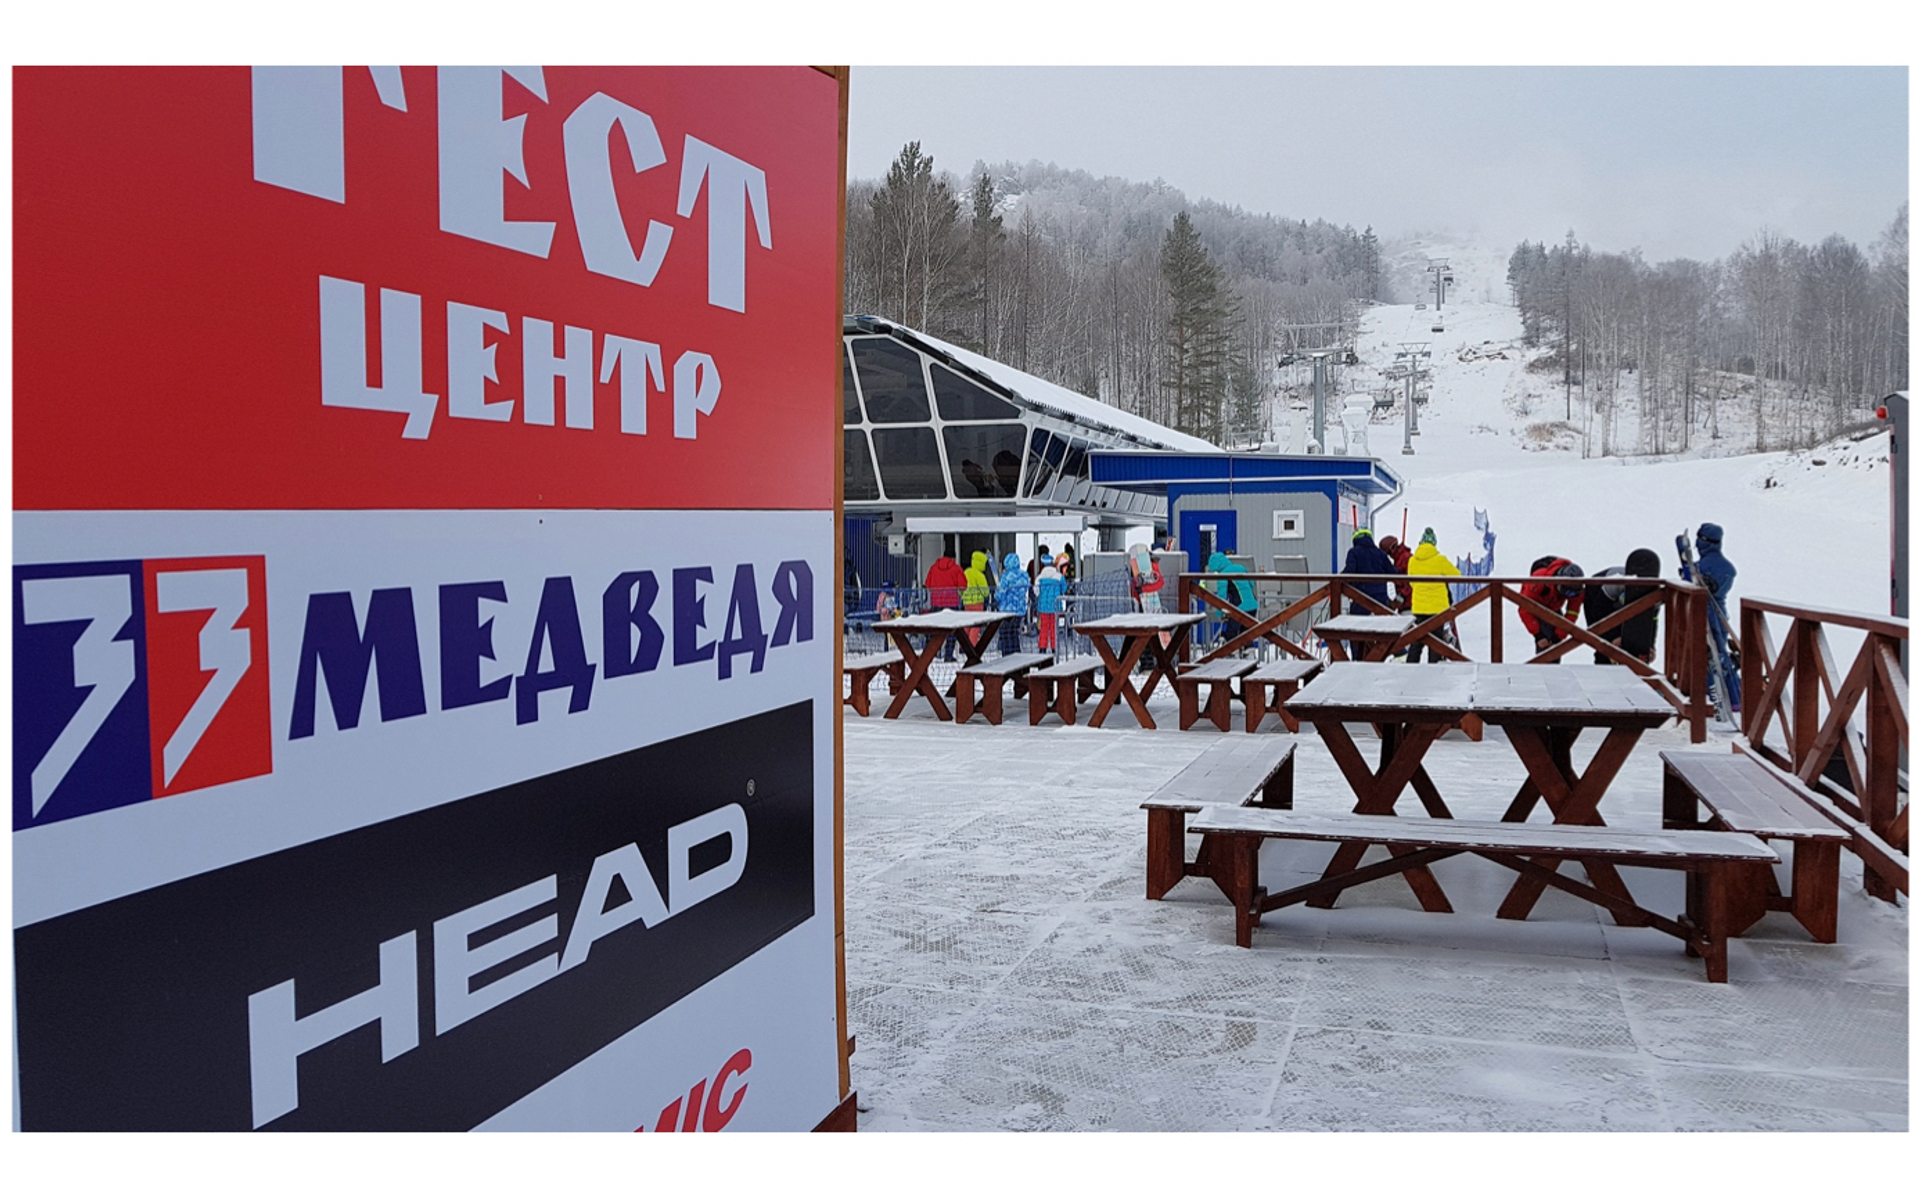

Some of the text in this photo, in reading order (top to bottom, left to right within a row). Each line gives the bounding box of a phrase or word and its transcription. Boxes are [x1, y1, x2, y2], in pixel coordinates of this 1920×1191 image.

[319, 275, 721, 439] ЦЕНТР
[288, 560, 814, 741] МЕДВЕДЯ
[248, 803, 748, 1130] HEAD
